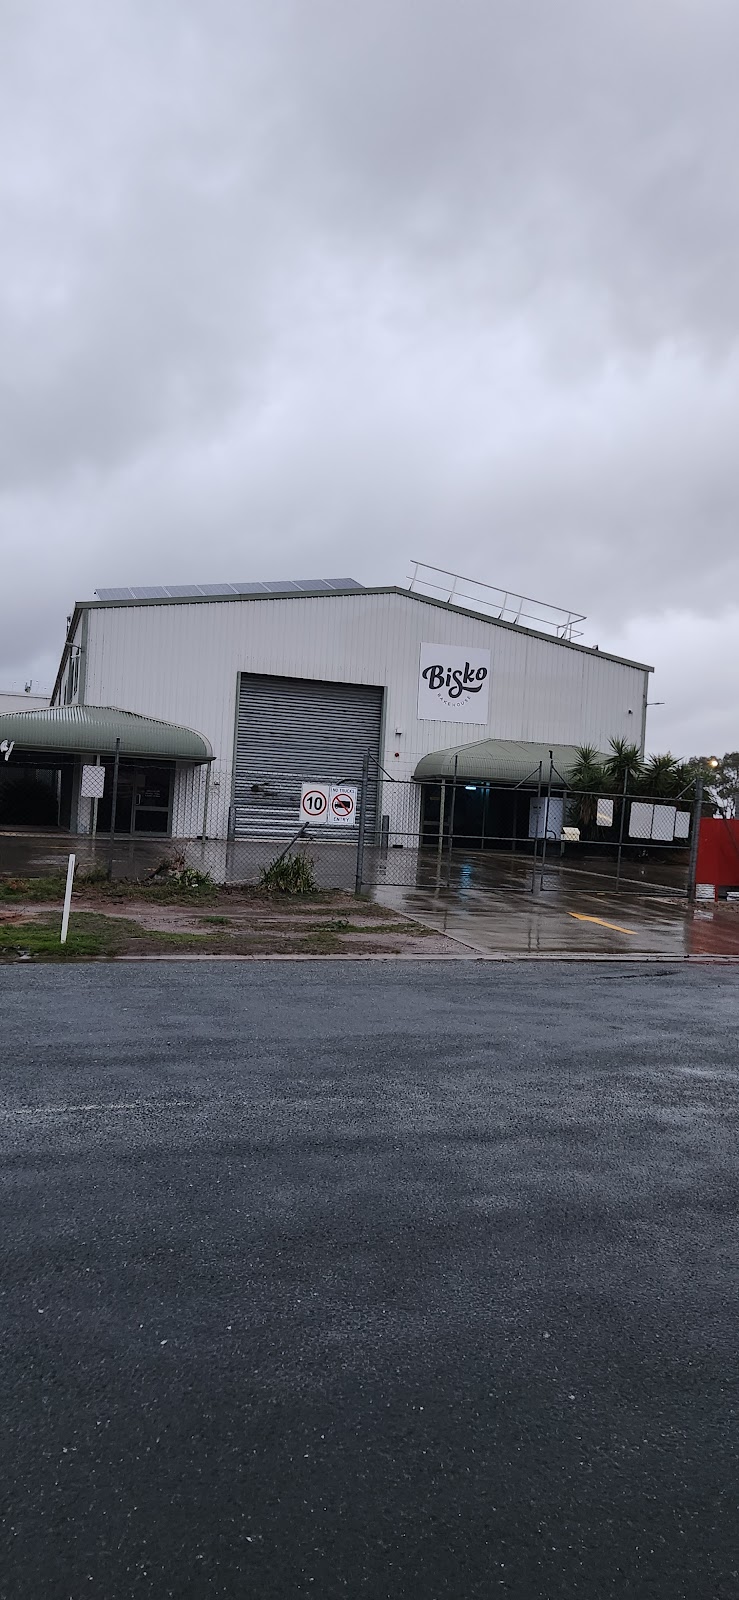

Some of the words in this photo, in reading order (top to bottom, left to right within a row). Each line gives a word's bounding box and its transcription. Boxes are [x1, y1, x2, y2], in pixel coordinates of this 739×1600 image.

[422, 662, 488, 698] Bisko
[437, 693, 471, 707] BAKEHOUSE
[307, 796, 322, 810] 10
